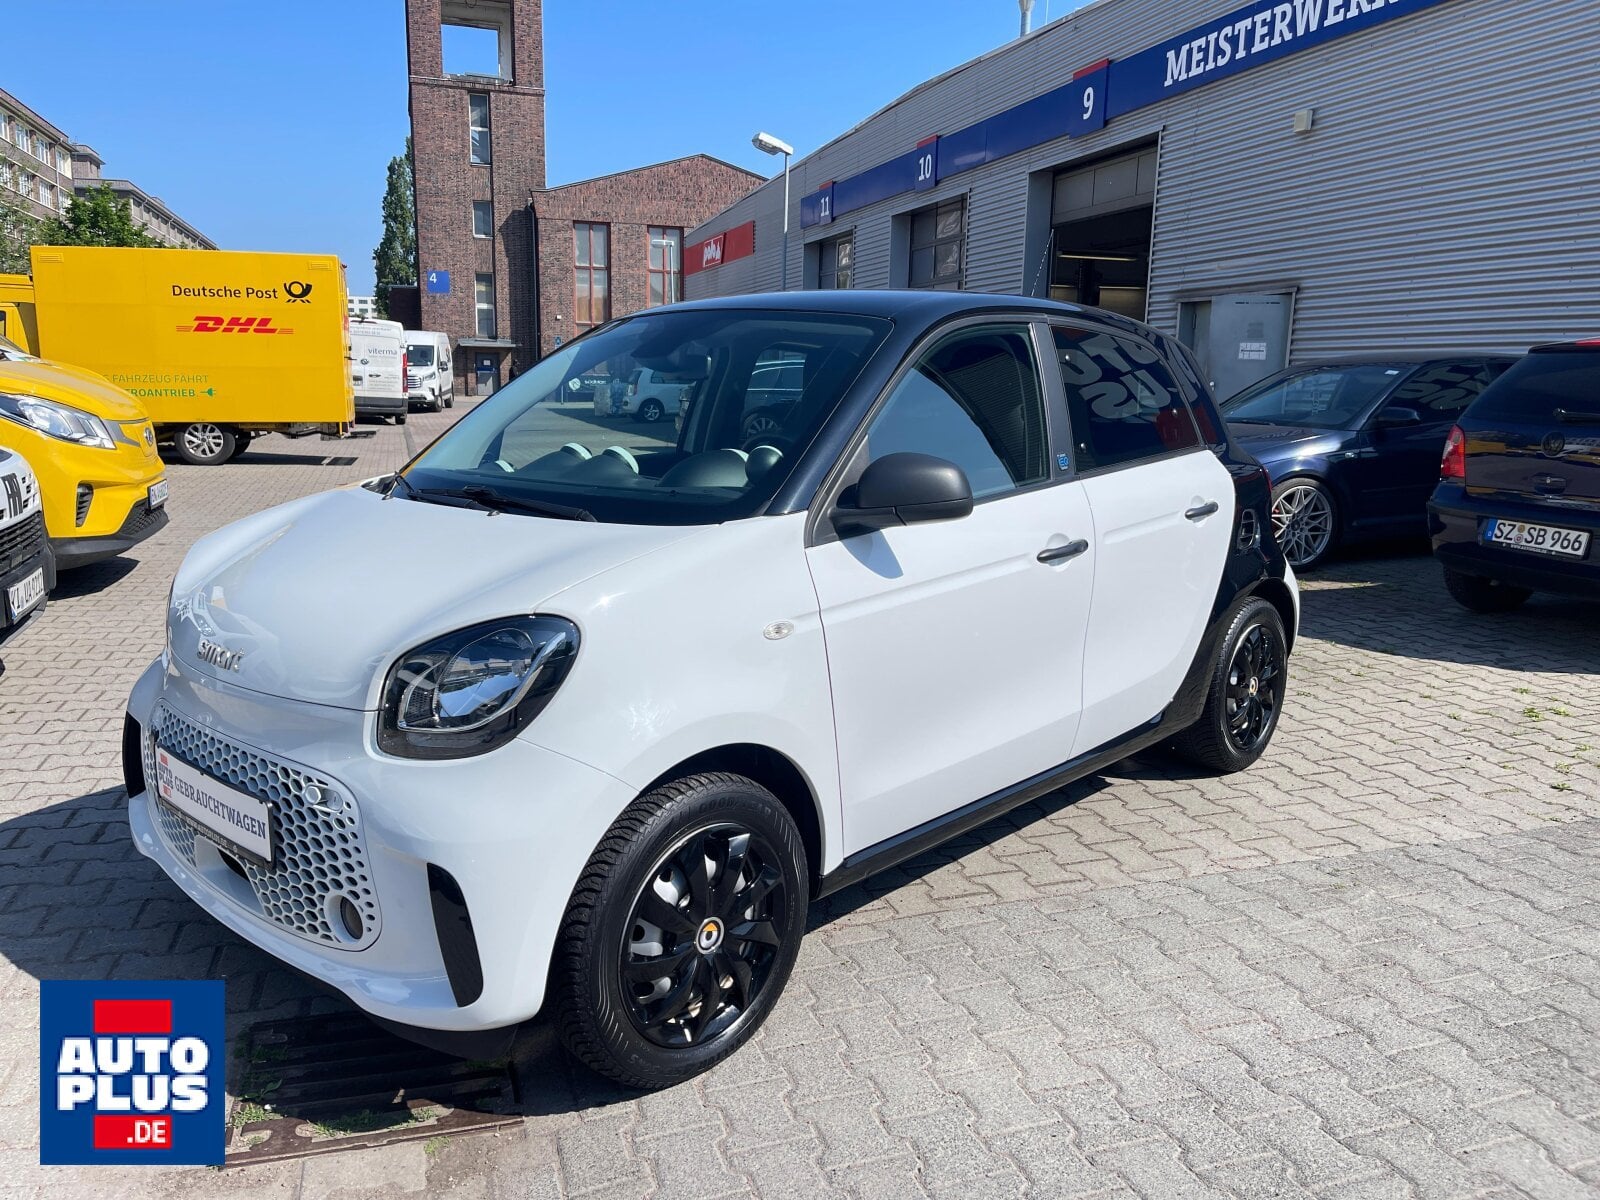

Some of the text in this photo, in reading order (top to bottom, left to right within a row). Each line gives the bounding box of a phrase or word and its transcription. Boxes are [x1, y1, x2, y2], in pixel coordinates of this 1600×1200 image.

[1083, 86, 1094, 120] 9
[918, 154, 932, 181] 10
[820, 196, 830, 217] 11
[429, 272, 437, 283] 4
[172, 284, 278, 299] Deutsche Post
[193, 315, 277, 334] DHL
[368, 347, 398, 355] viterma
[112, 374, 171, 383] FAHRZEUG
[1494, 522, 1517, 541] SZ
[1524, 526, 1548, 546] SB
[1549, 531, 1583, 552] 966
[197, 639, 244, 673] smart
[174, 775, 266, 839] GEBRAUCHTWAGEN
